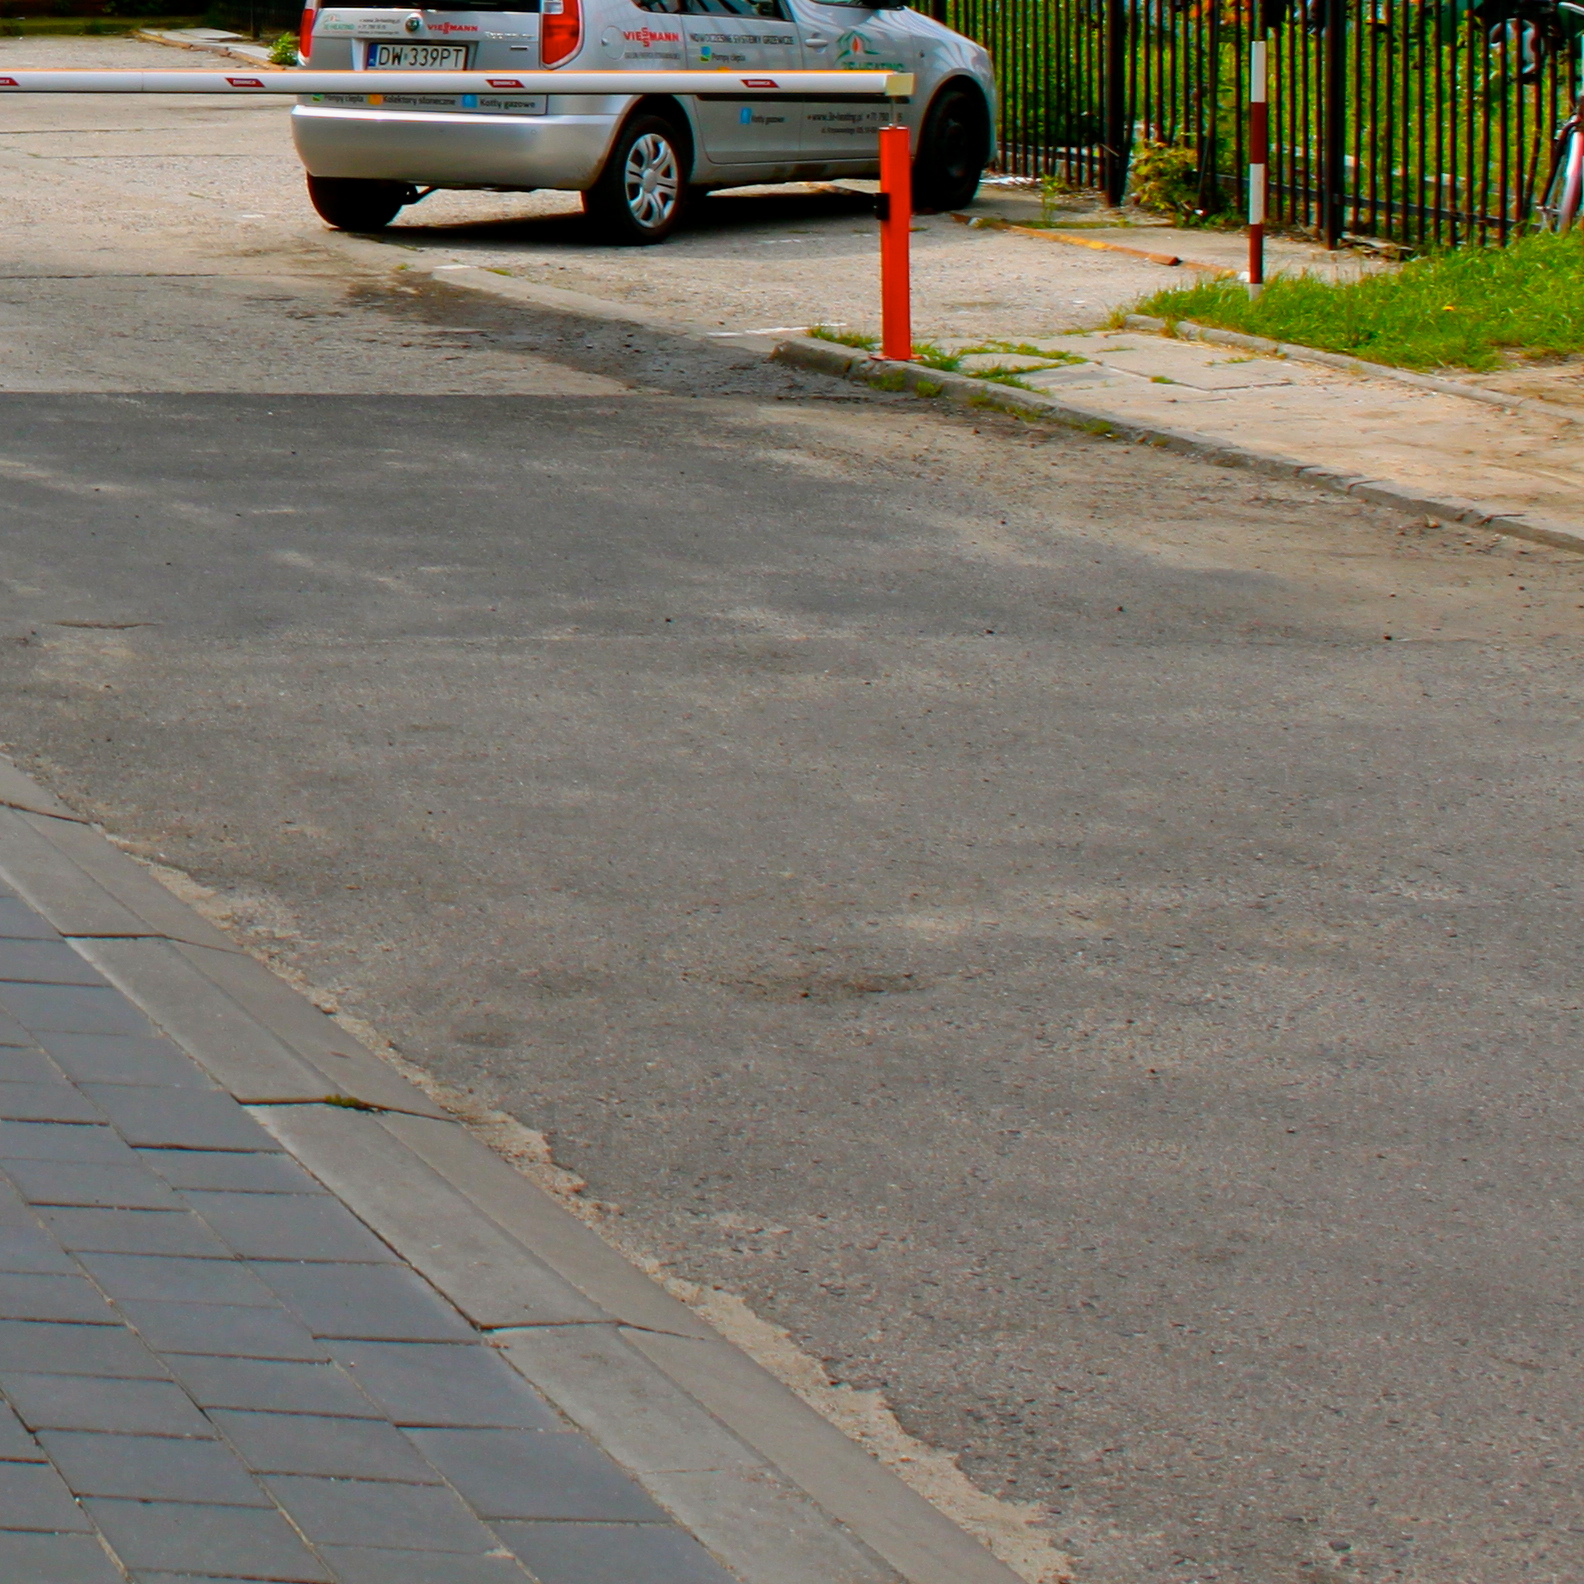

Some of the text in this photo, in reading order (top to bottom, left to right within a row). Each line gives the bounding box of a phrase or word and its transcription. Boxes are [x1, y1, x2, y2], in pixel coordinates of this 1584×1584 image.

[427, 21, 478, 35] VIESSMANN
[623, 27, 680, 48] VIESSMANN
[379, 47, 463, 68] DW 339PT
